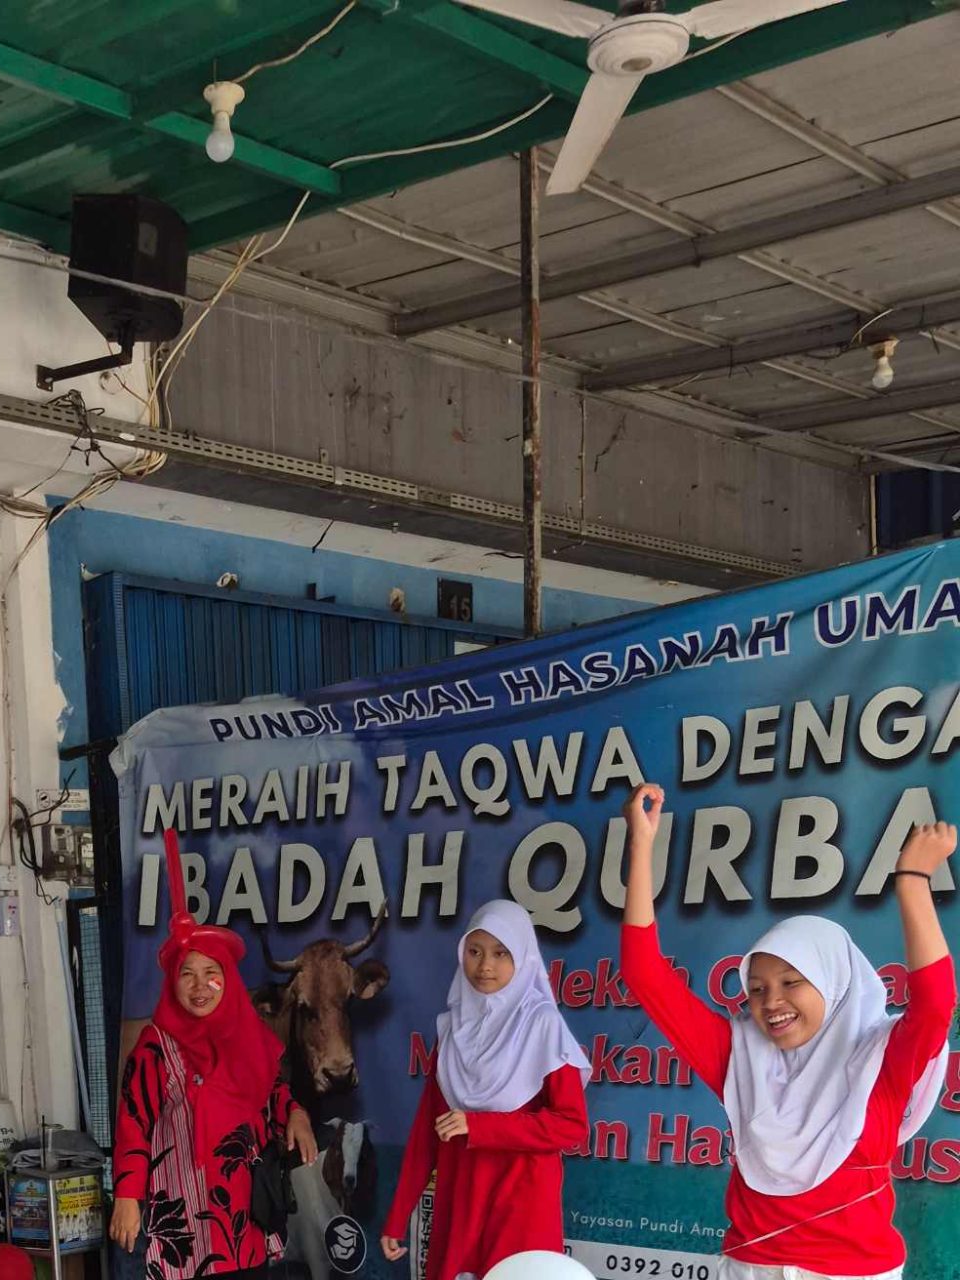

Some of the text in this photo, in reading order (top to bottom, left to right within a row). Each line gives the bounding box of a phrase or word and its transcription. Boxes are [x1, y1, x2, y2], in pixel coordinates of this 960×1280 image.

[450, 595, 471, 621] 15
[209, 578, 960, 742] PUNDI AMAL HASANAH UMA
[142, 760, 351, 833] MERAIH
[377, 726, 646, 816] TAQWA
[137, 786, 958, 934] IBADAH QURBA
[571, 1211, 725, 1238] Yayasan Pundi Ama
[606, 1254, 661, 1276] 0392
